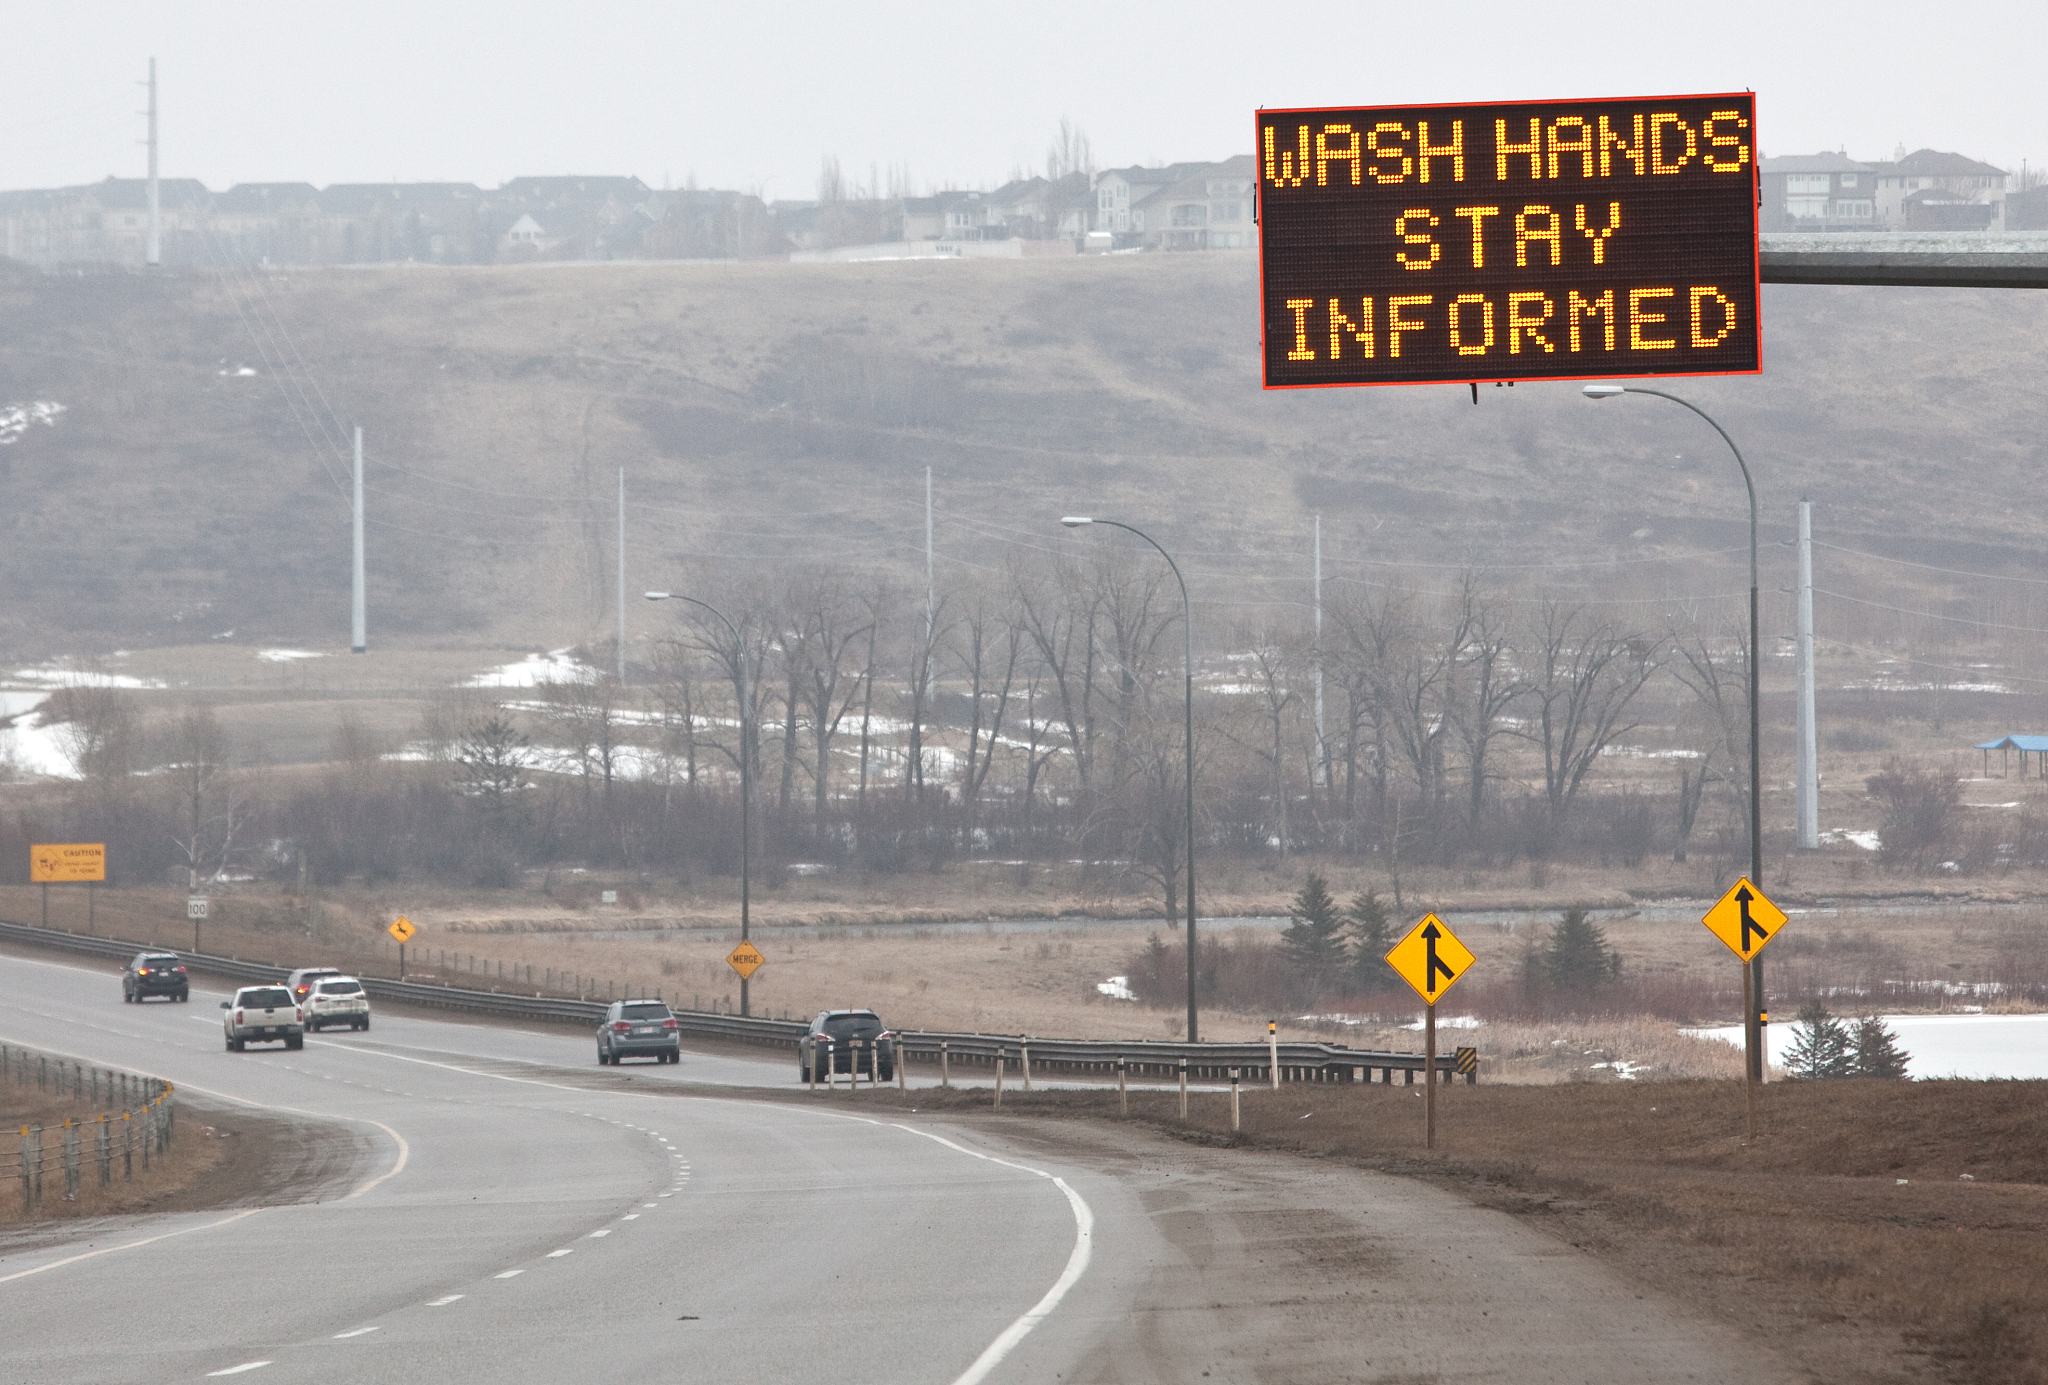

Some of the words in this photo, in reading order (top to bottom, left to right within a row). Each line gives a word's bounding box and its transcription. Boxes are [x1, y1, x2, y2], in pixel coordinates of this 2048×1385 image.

[1265, 120, 1464, 187] WASH
[1495, 110, 1749, 181] HANDS
[1395, 202, 1621, 270] STAY
[1286, 286, 1735, 361] INFORMED
[63, 849, 102, 858] CAUTION
[189, 903, 206, 915] 100
[732, 954, 759, 964] MERGE
